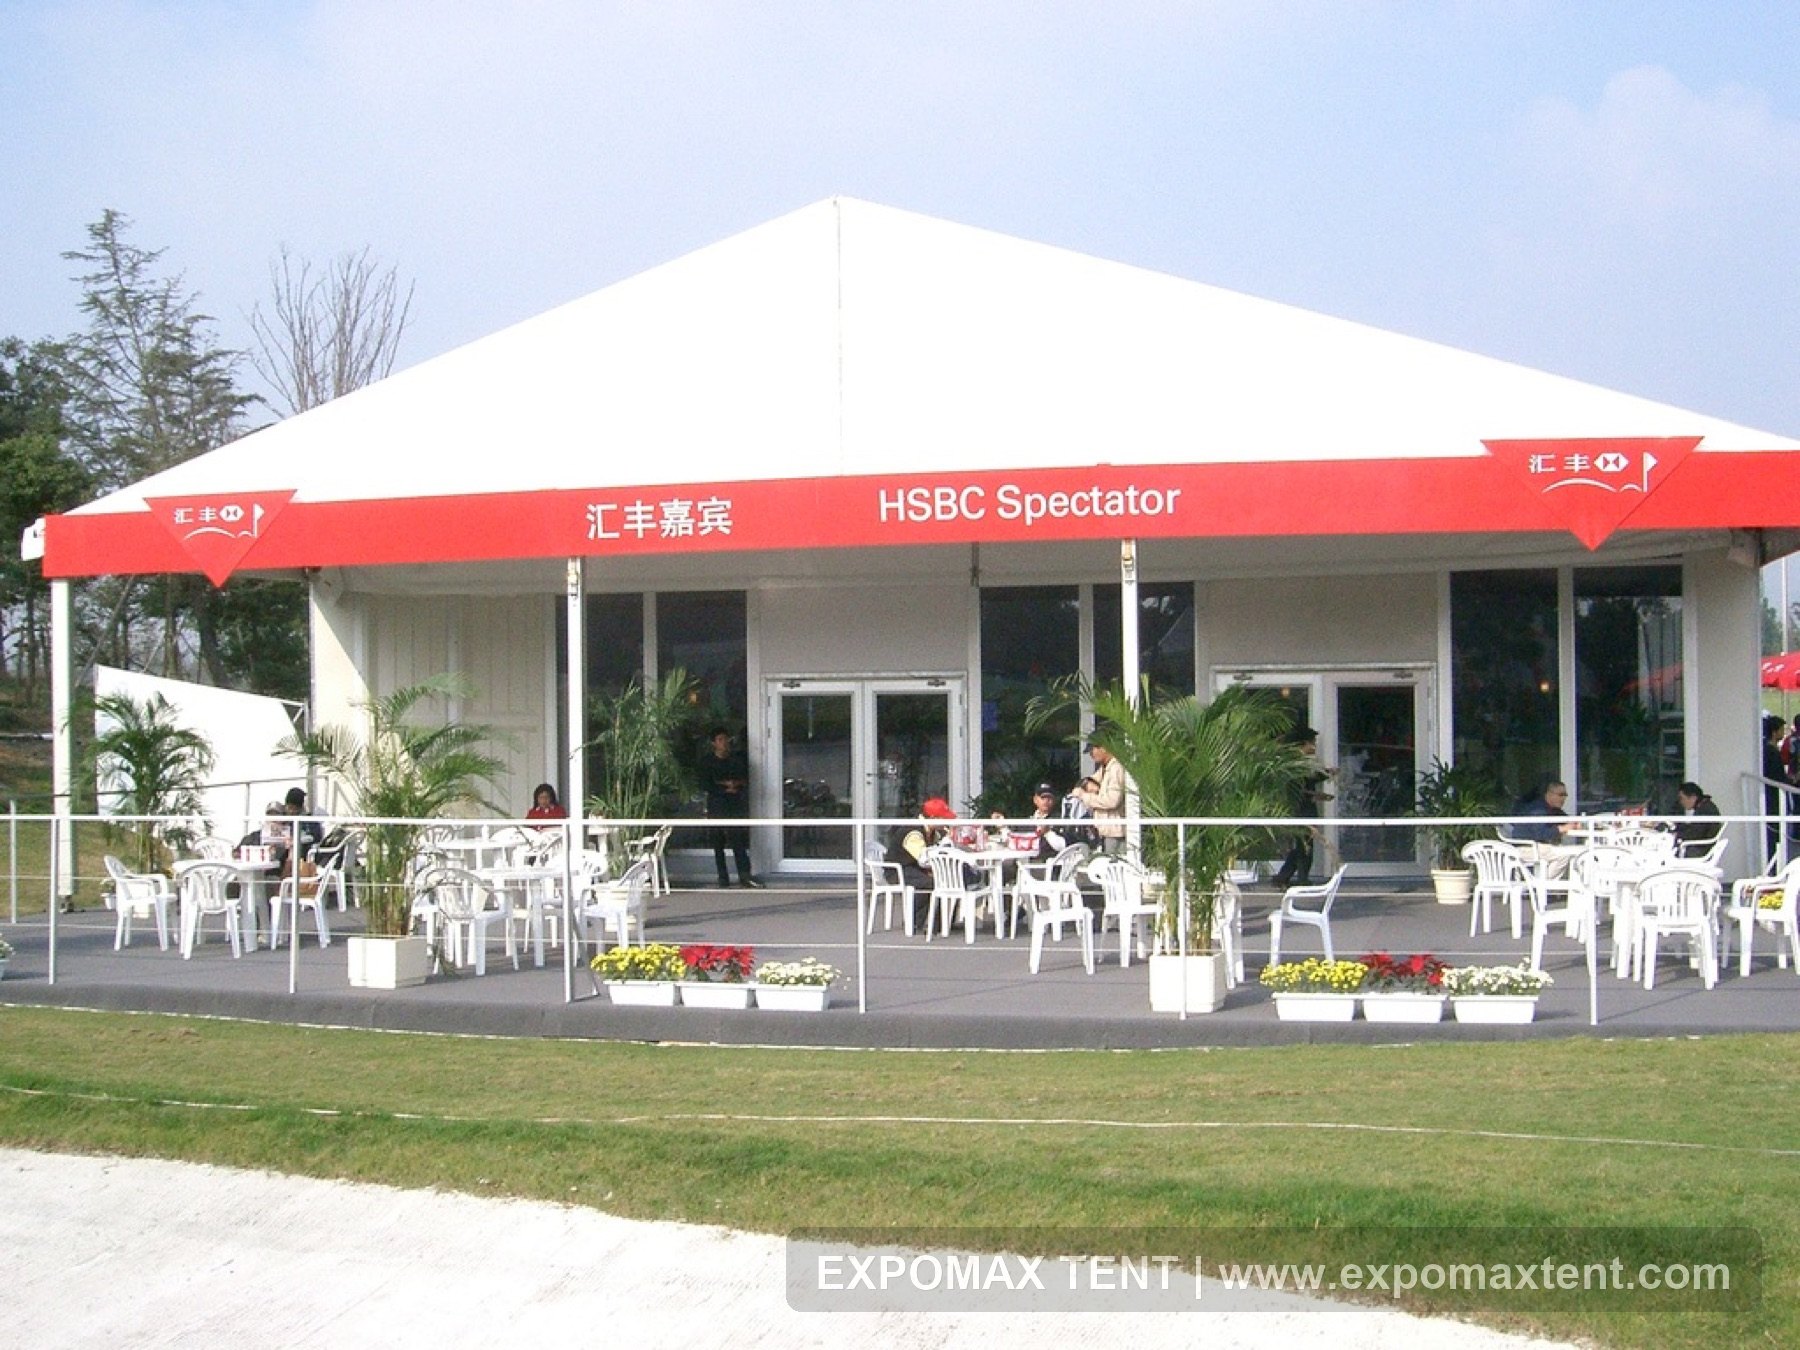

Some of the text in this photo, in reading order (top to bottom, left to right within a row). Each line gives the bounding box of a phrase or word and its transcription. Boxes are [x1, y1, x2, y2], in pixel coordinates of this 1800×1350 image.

[1528, 453, 1590, 474] 汇丰
[585, 495, 734, 541] 汇丰嘉宾
[878, 482, 1182, 526] HSBC Spectator
